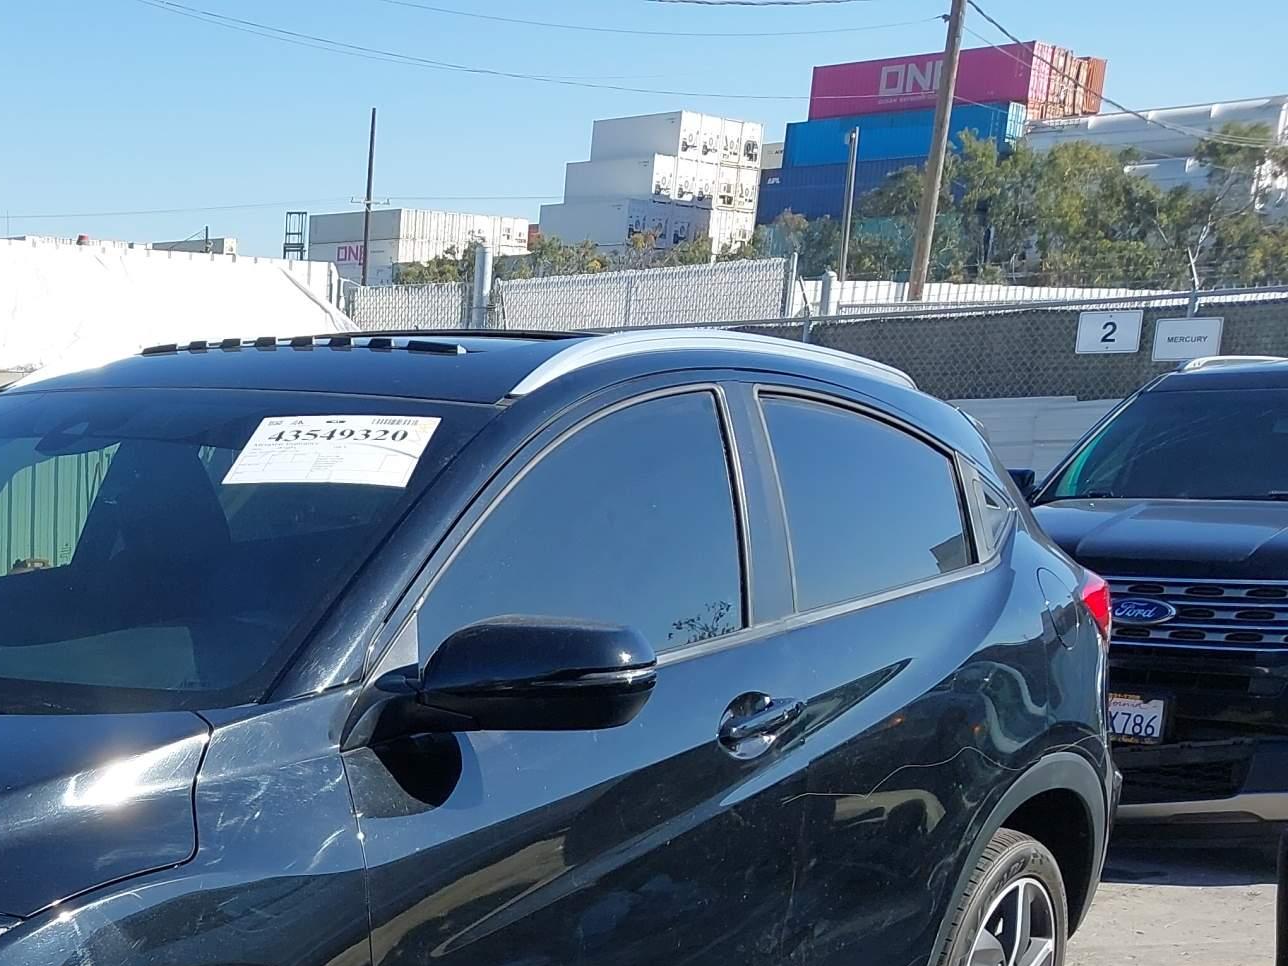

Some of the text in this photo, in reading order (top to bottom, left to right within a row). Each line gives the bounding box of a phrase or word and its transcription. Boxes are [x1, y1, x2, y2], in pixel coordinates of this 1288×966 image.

[1101, 322, 1117, 342] 2
[1167, 335, 1208, 344] MERCURY
[268, 429, 408, 441] 43549320
[1114, 601, 1158, 617] Ford
